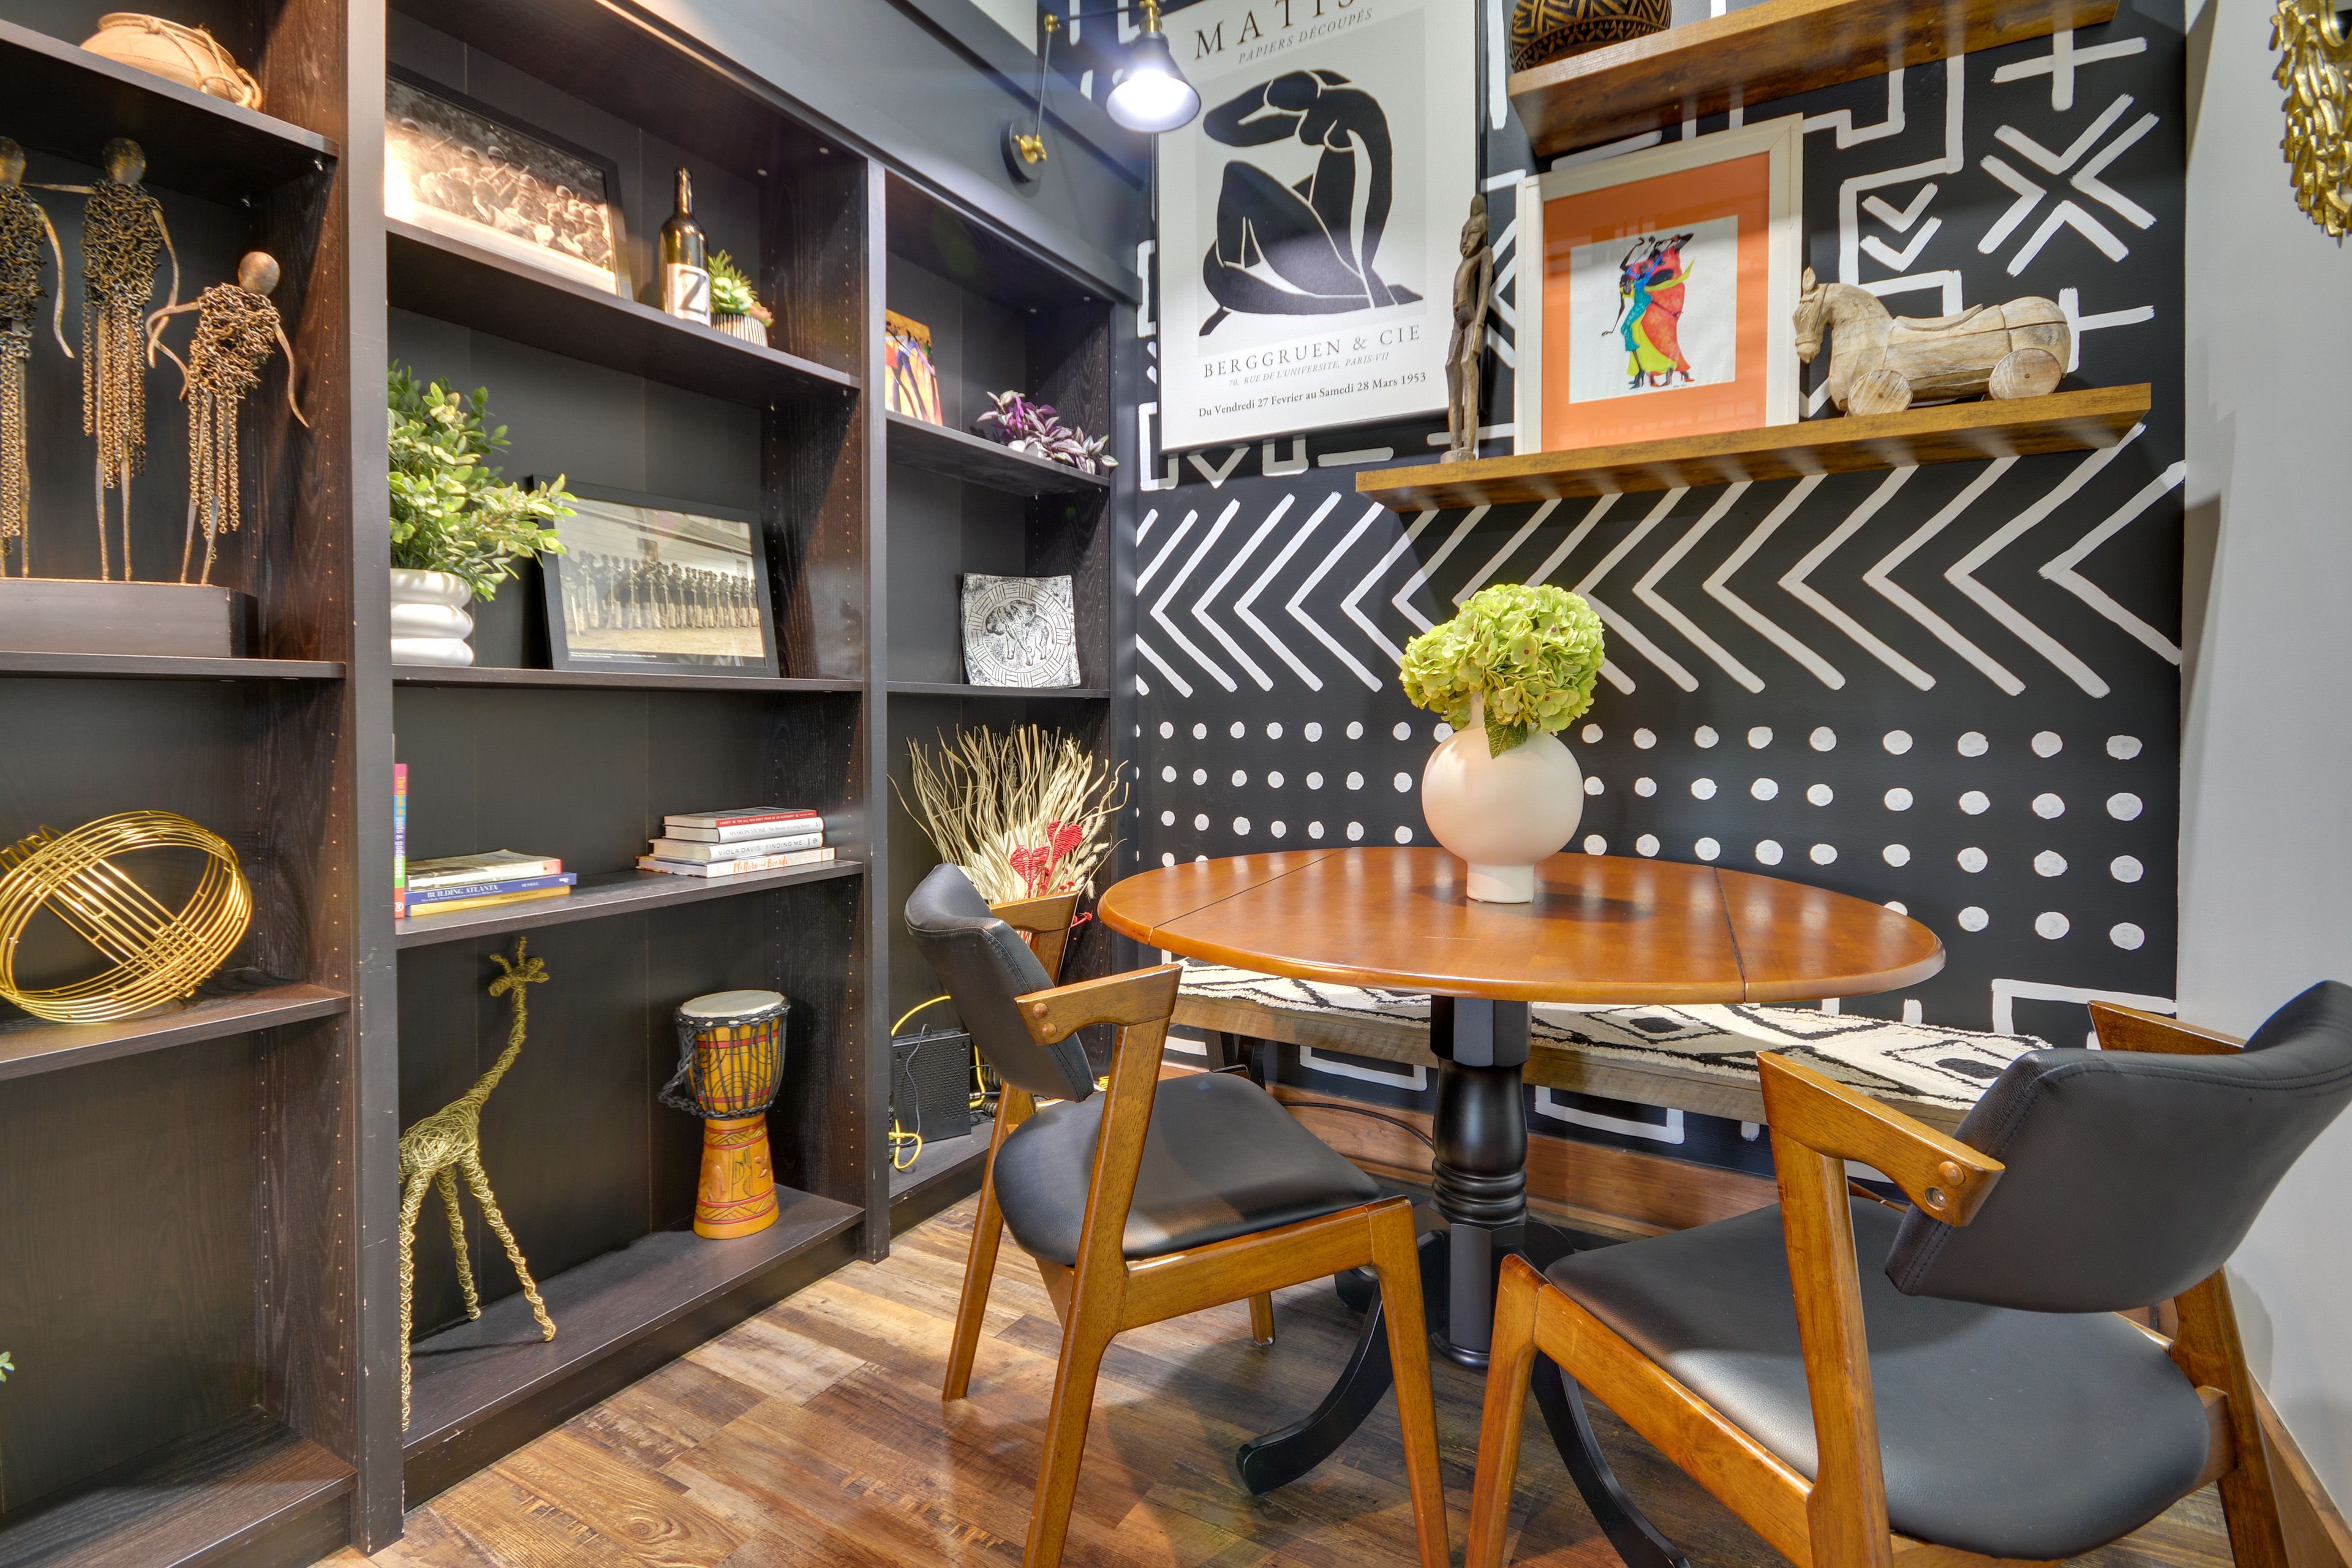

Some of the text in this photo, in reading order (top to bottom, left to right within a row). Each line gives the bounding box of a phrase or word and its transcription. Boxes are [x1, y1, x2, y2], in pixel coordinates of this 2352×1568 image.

[1194, 0, 1354, 59] MATI
[1238, 7, 1373, 63] PAPIERS DÉCOUPÉS
[1204, 324, 1420, 378] BERGGRUEN & CIE
[1243, 374, 1261, 385] RUE
[1262, 371, 1275, 381] DE
[1344, 351, 1390, 367] PARIS-VII
[1199, 371, 1427, 418] Du Vendredi 27 Fevrier au Samedi 28 Mars 1953
[766, 842, 792, 850] FINDING
[427, 888, 464, 899] BUILDING
